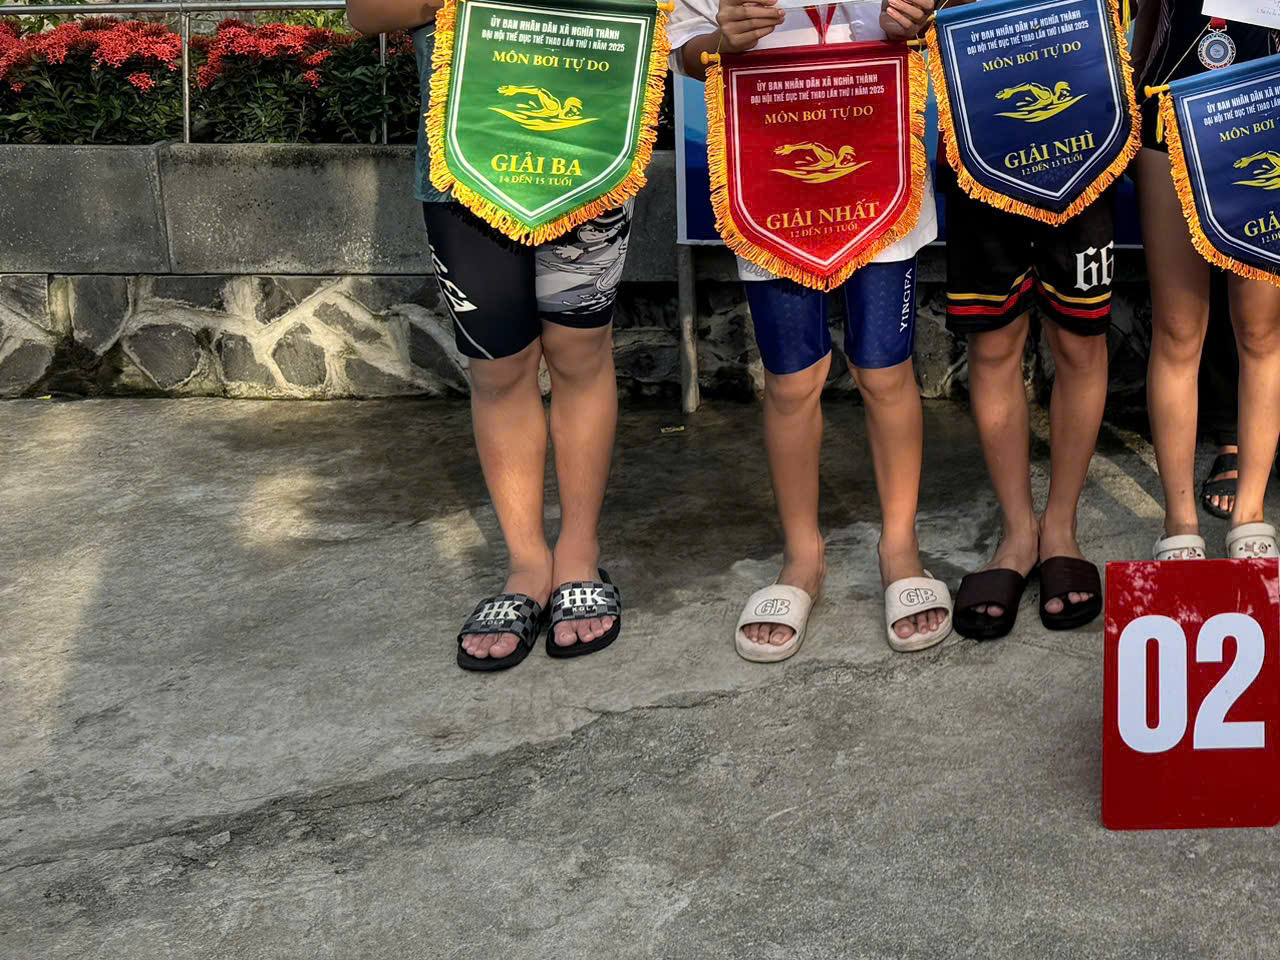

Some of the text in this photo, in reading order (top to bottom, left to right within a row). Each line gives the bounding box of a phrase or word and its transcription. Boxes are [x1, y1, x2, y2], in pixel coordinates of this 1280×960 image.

[503, 18, 517, 29] BAN
[492, 50, 610, 72] MÔN BƠI TỰ DO
[983, 41, 1082, 72] MÔN BƠI TỰ DO
[768, 80, 783, 90] BAN
[764, 105, 873, 125] MÔN BƠI TỰ DO
[1220, 127, 1250, 142] MÔN
[1253, 119, 1275, 134] BƠI
[1004, 130, 1096, 169] GIẢI NHÌ
[491, 151, 582, 176] GIẢI BA
[1021, 167, 1031, 175] 12
[767, 198, 880, 230] GIẢI NHẤT
[790, 230, 800, 239] 12
[1261, 235, 1270, 244] 12
[1117, 614, 1265, 753] 02
